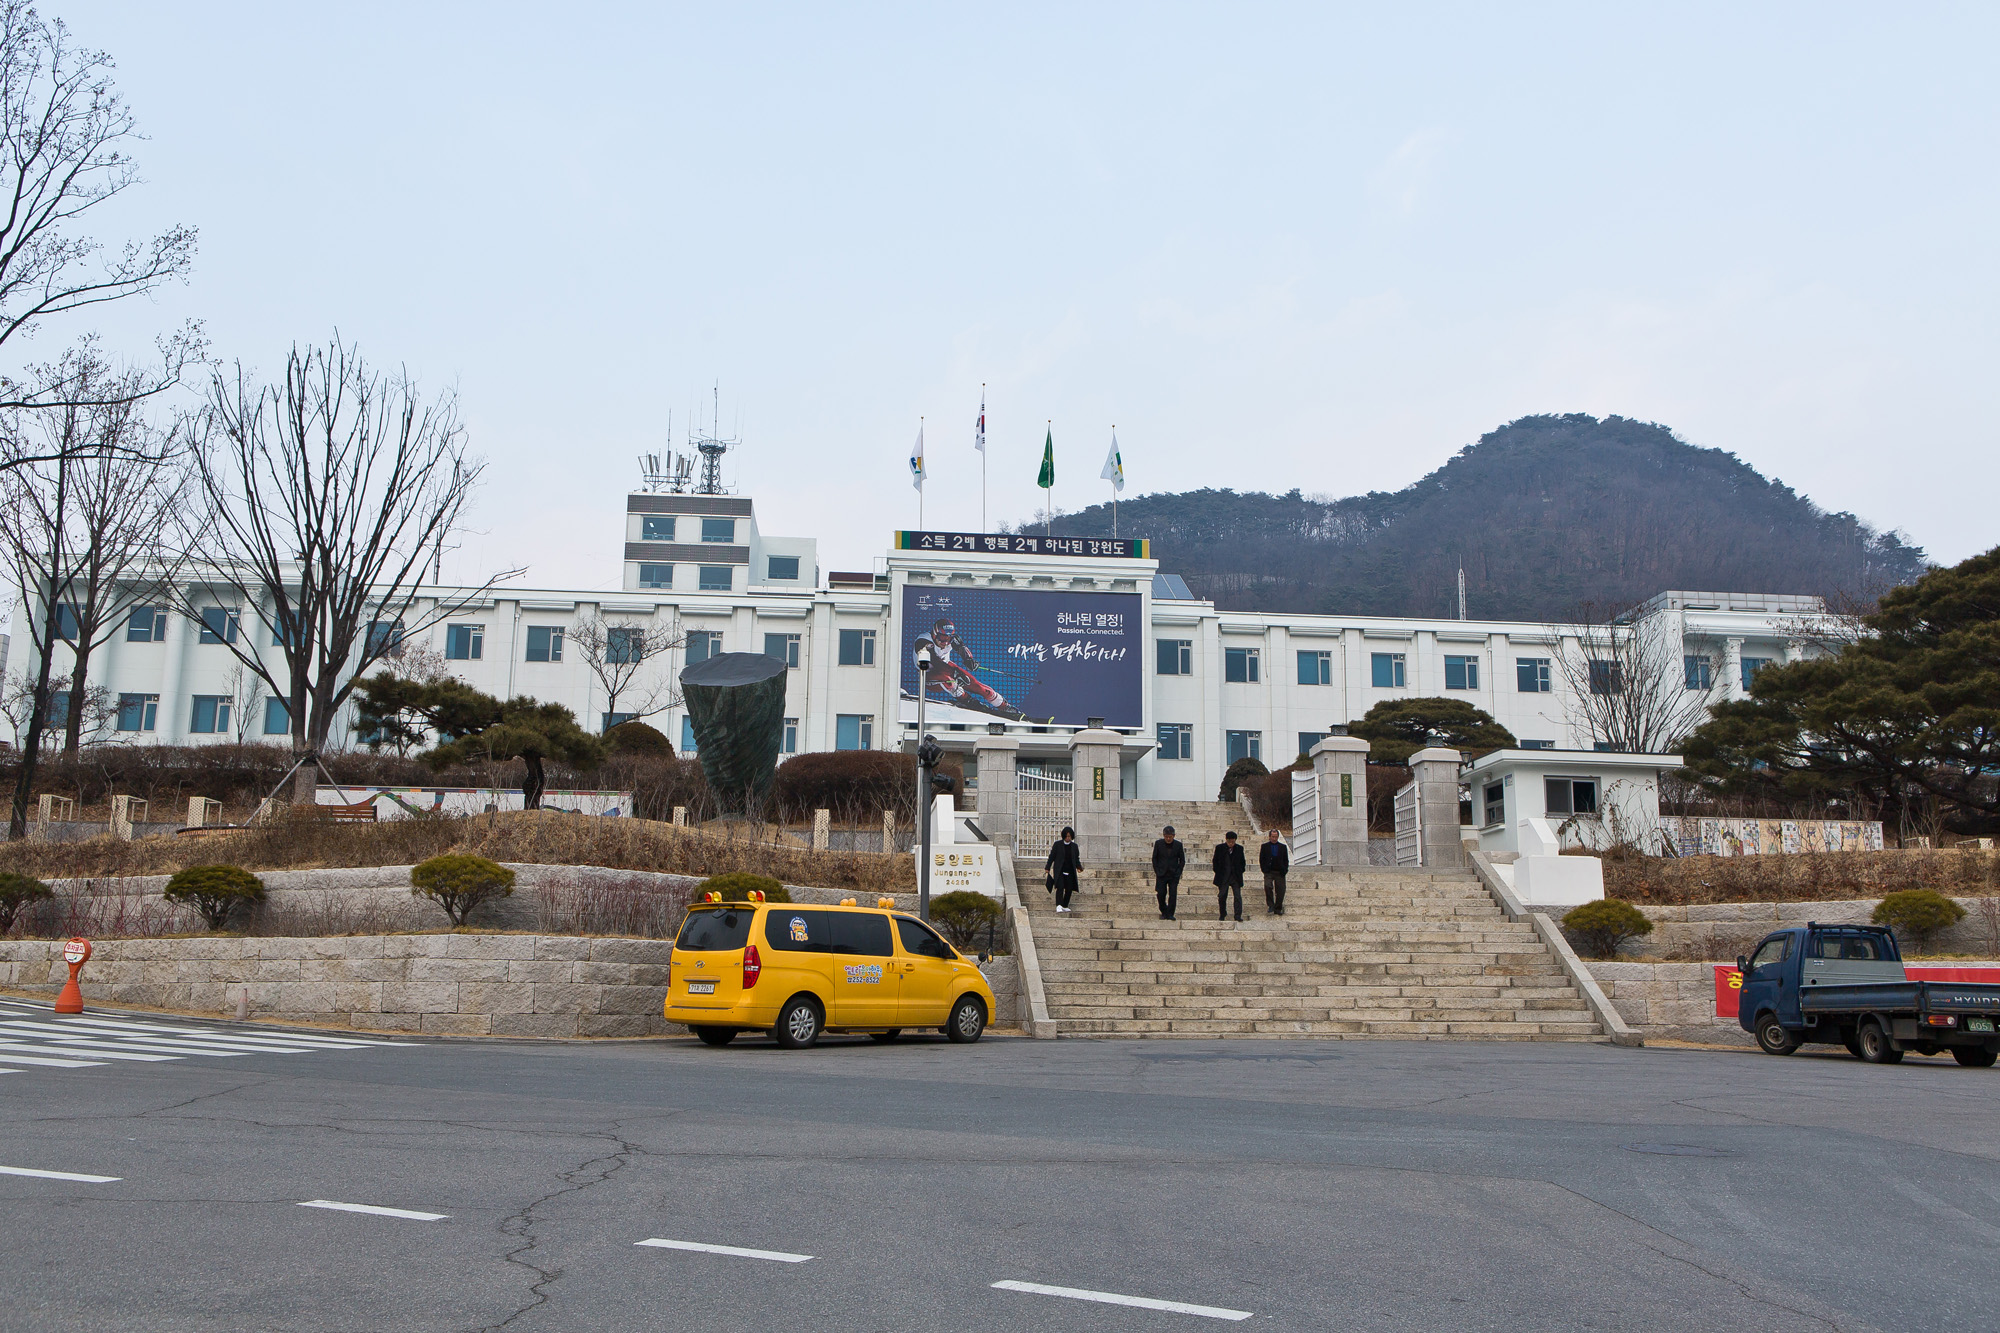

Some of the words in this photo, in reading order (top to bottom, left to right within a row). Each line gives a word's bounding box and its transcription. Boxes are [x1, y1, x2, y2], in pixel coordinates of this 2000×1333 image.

[921, 534, 946, 549] 소득
[953, 535, 975, 550] 2배
[984, 537, 1008, 551] 행복
[1016, 538, 1037, 552] 2배
[1045, 538, 1083, 554] 하나된
[1088, 540, 1125, 555] 강원도
[1057, 612, 1092, 626] 하나된
[1095, 613, 1123, 627] 열정!
[1057, 627, 1086, 635] Passion.
[1086, 628, 1125, 636] Connected.
[1008, 642, 1049, 662] 이제는
[1052, 640, 1127, 662] 평창이다!
[934, 853, 973, 867] 중앙로
[978, 854, 983, 866] 1
[934, 869, 981, 877] Jungang-ro
[852, 976, 880, 984] 252-8522
